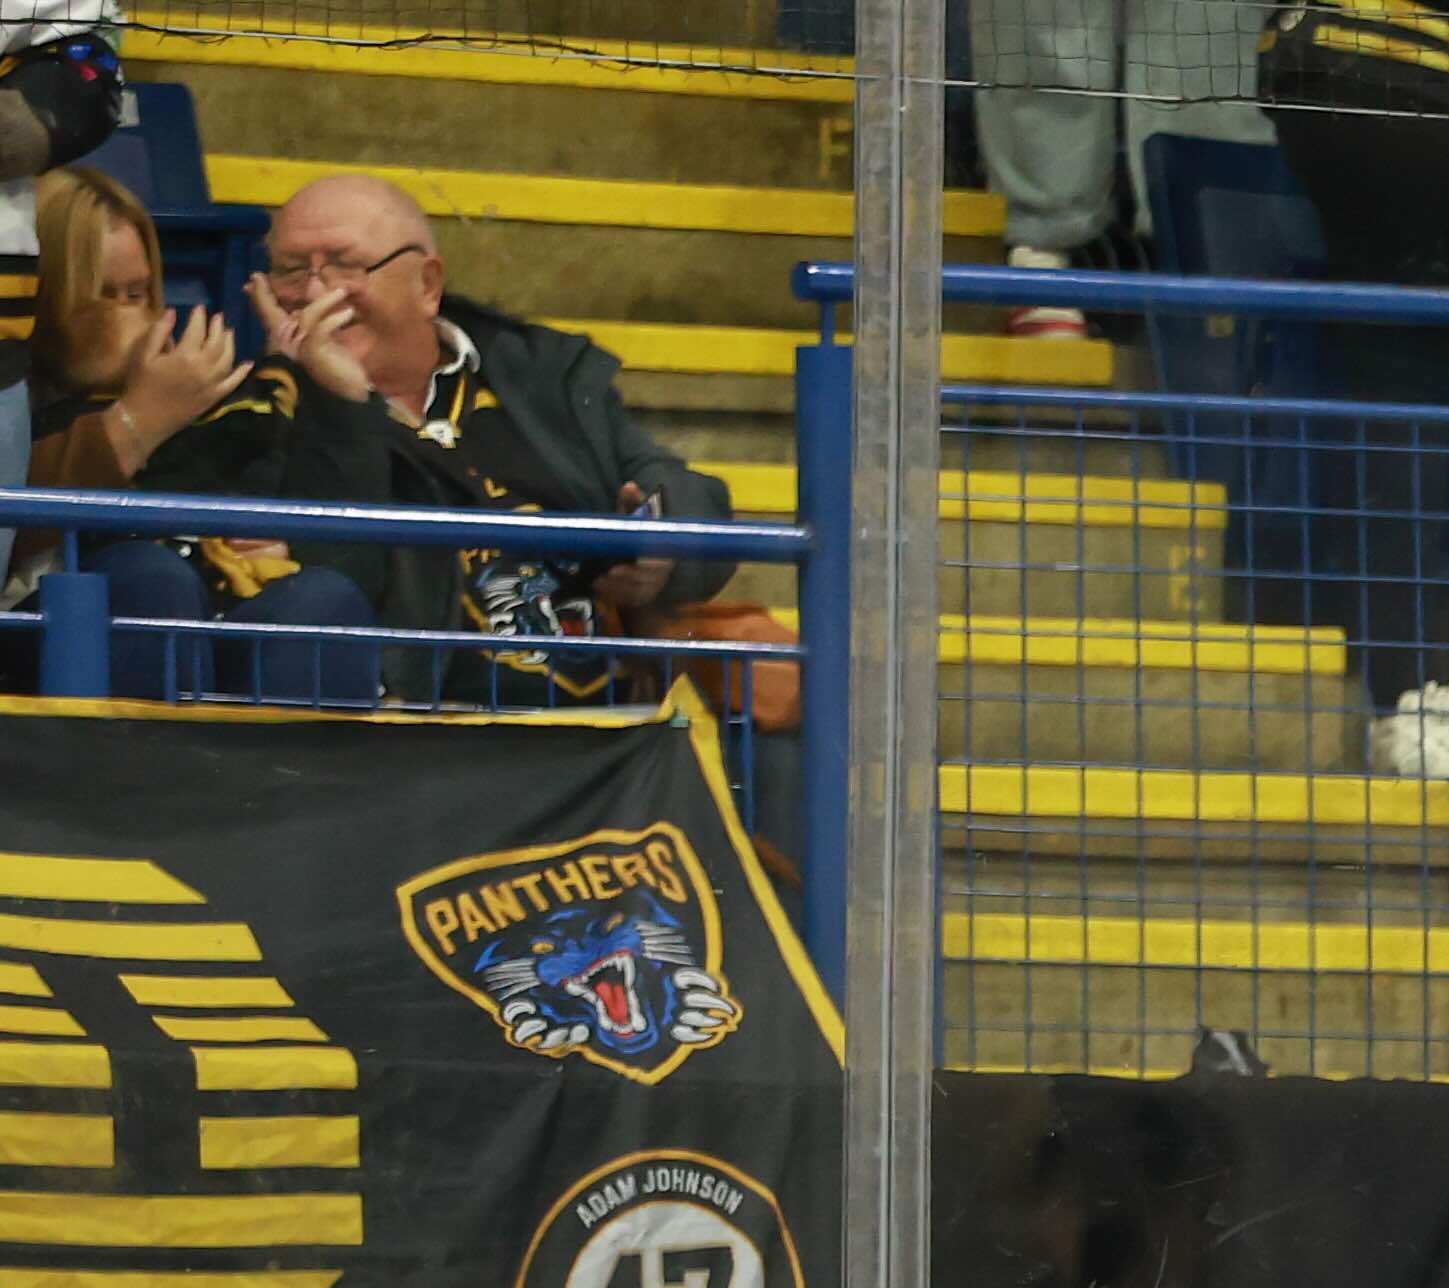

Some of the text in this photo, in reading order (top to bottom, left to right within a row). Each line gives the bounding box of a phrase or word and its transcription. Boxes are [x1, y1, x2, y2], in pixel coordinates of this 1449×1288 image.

[426, 840, 688, 956] PANTHERS
[575, 1166, 744, 1229] ADAM JOHNSON
